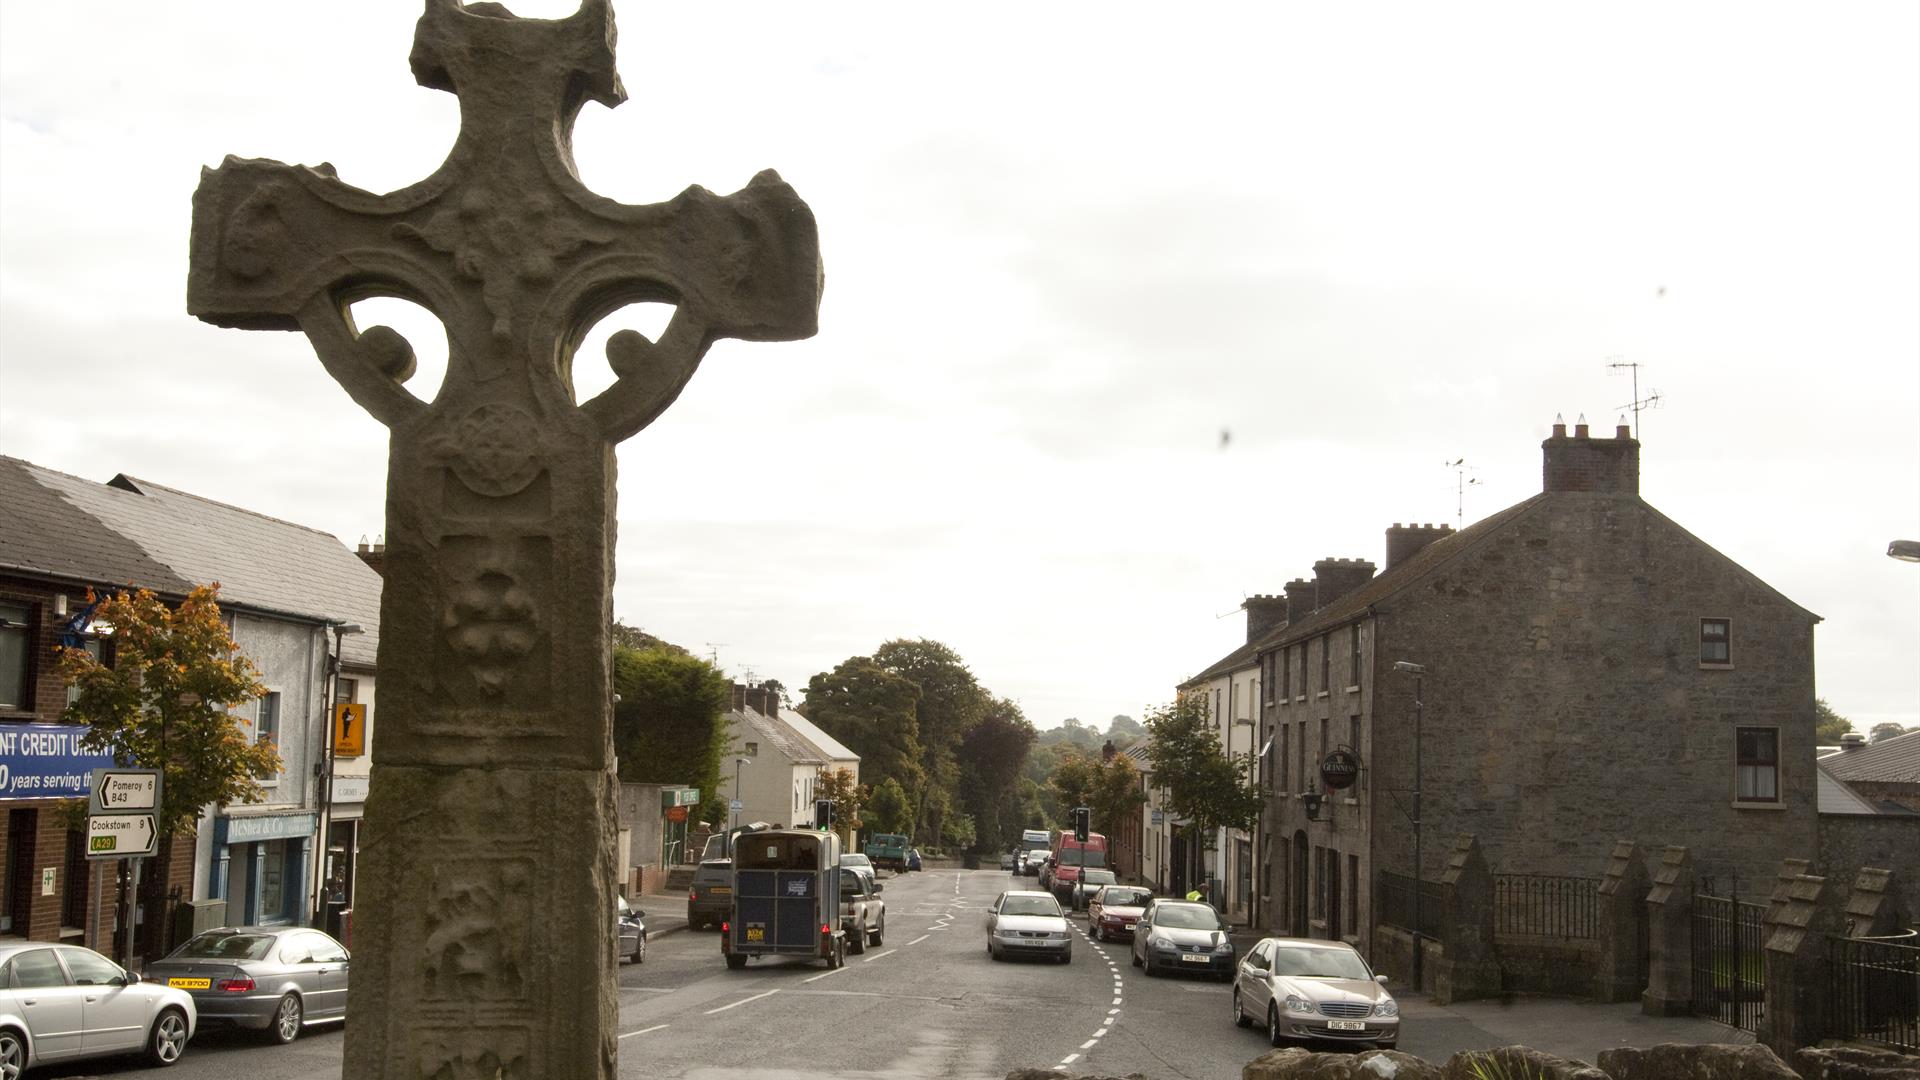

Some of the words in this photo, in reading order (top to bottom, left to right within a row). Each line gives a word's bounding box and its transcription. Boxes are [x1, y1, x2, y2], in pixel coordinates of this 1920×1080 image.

[20, 733, 68, 756] CREDIT
[10, 774, 40, 792] years
[43, 771, 81, 791] serving
[112, 780, 143, 791] Pomeroy
[147, 780, 153, 791] 6
[111, 793, 128, 802] B43
[91, 820, 131, 830] Cookstown
[139, 819, 145, 829] 9
[262, 818, 271, 834] &
[91, 837, 116, 850] (A29)
